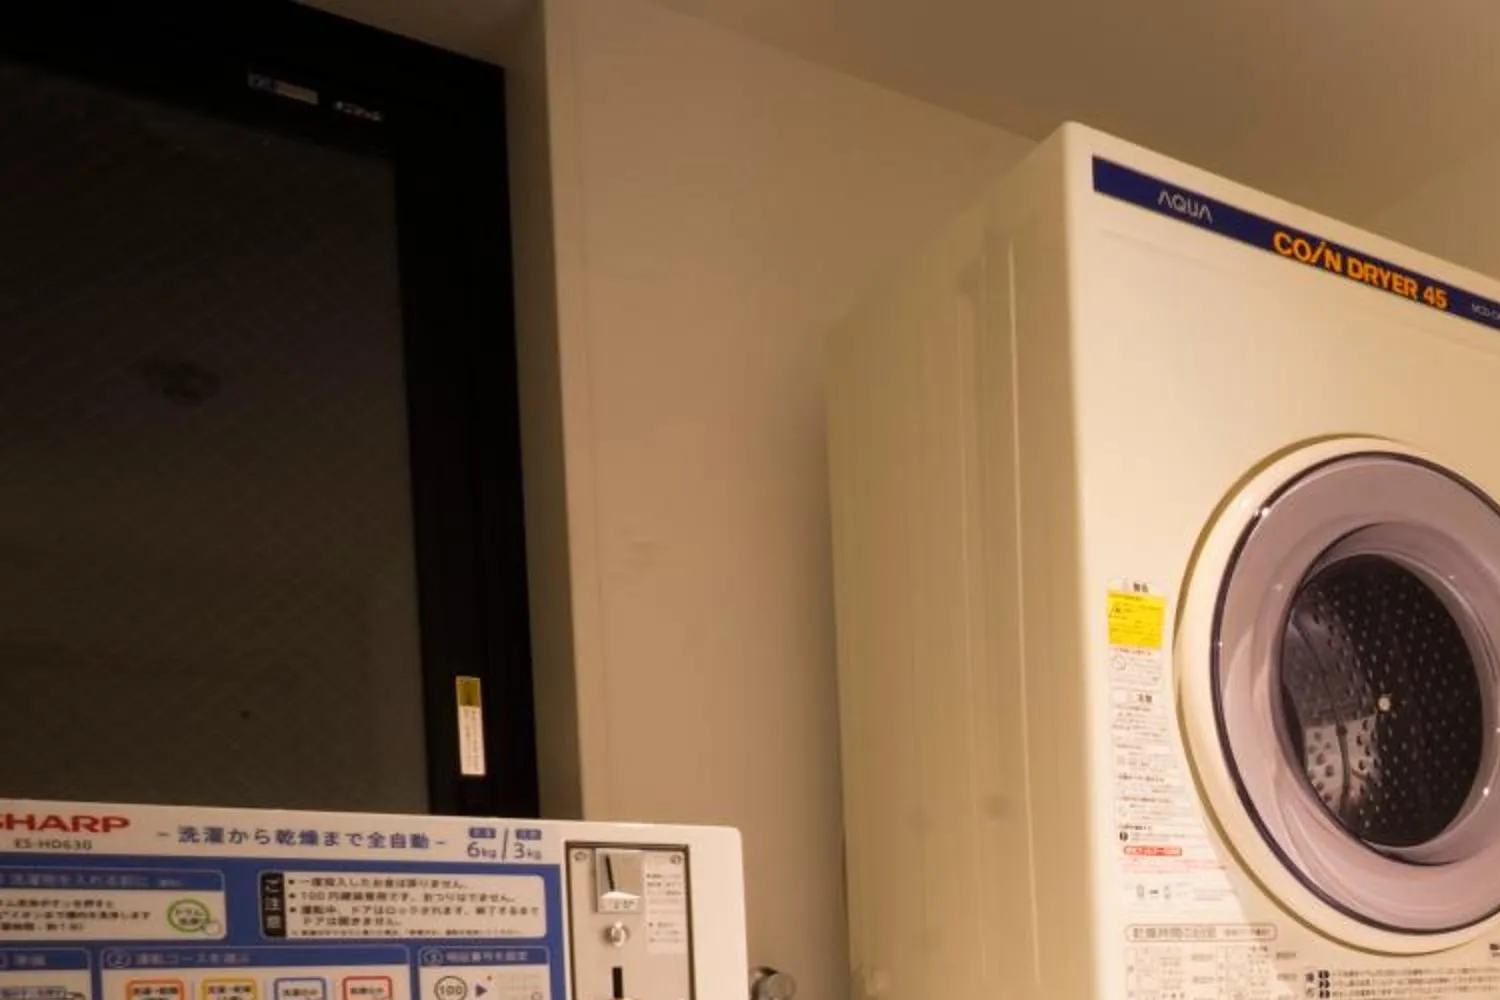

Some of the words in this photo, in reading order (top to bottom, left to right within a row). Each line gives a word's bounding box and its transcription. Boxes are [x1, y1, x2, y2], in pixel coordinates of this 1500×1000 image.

[1157, 189, 1213, 224] AQUA
[1272, 230, 1342, 274] COIN
[1346, 256, 1418, 301] DRYER
[1422, 285, 1449, 312] 45
[0, 812, 131, 833] HARP
